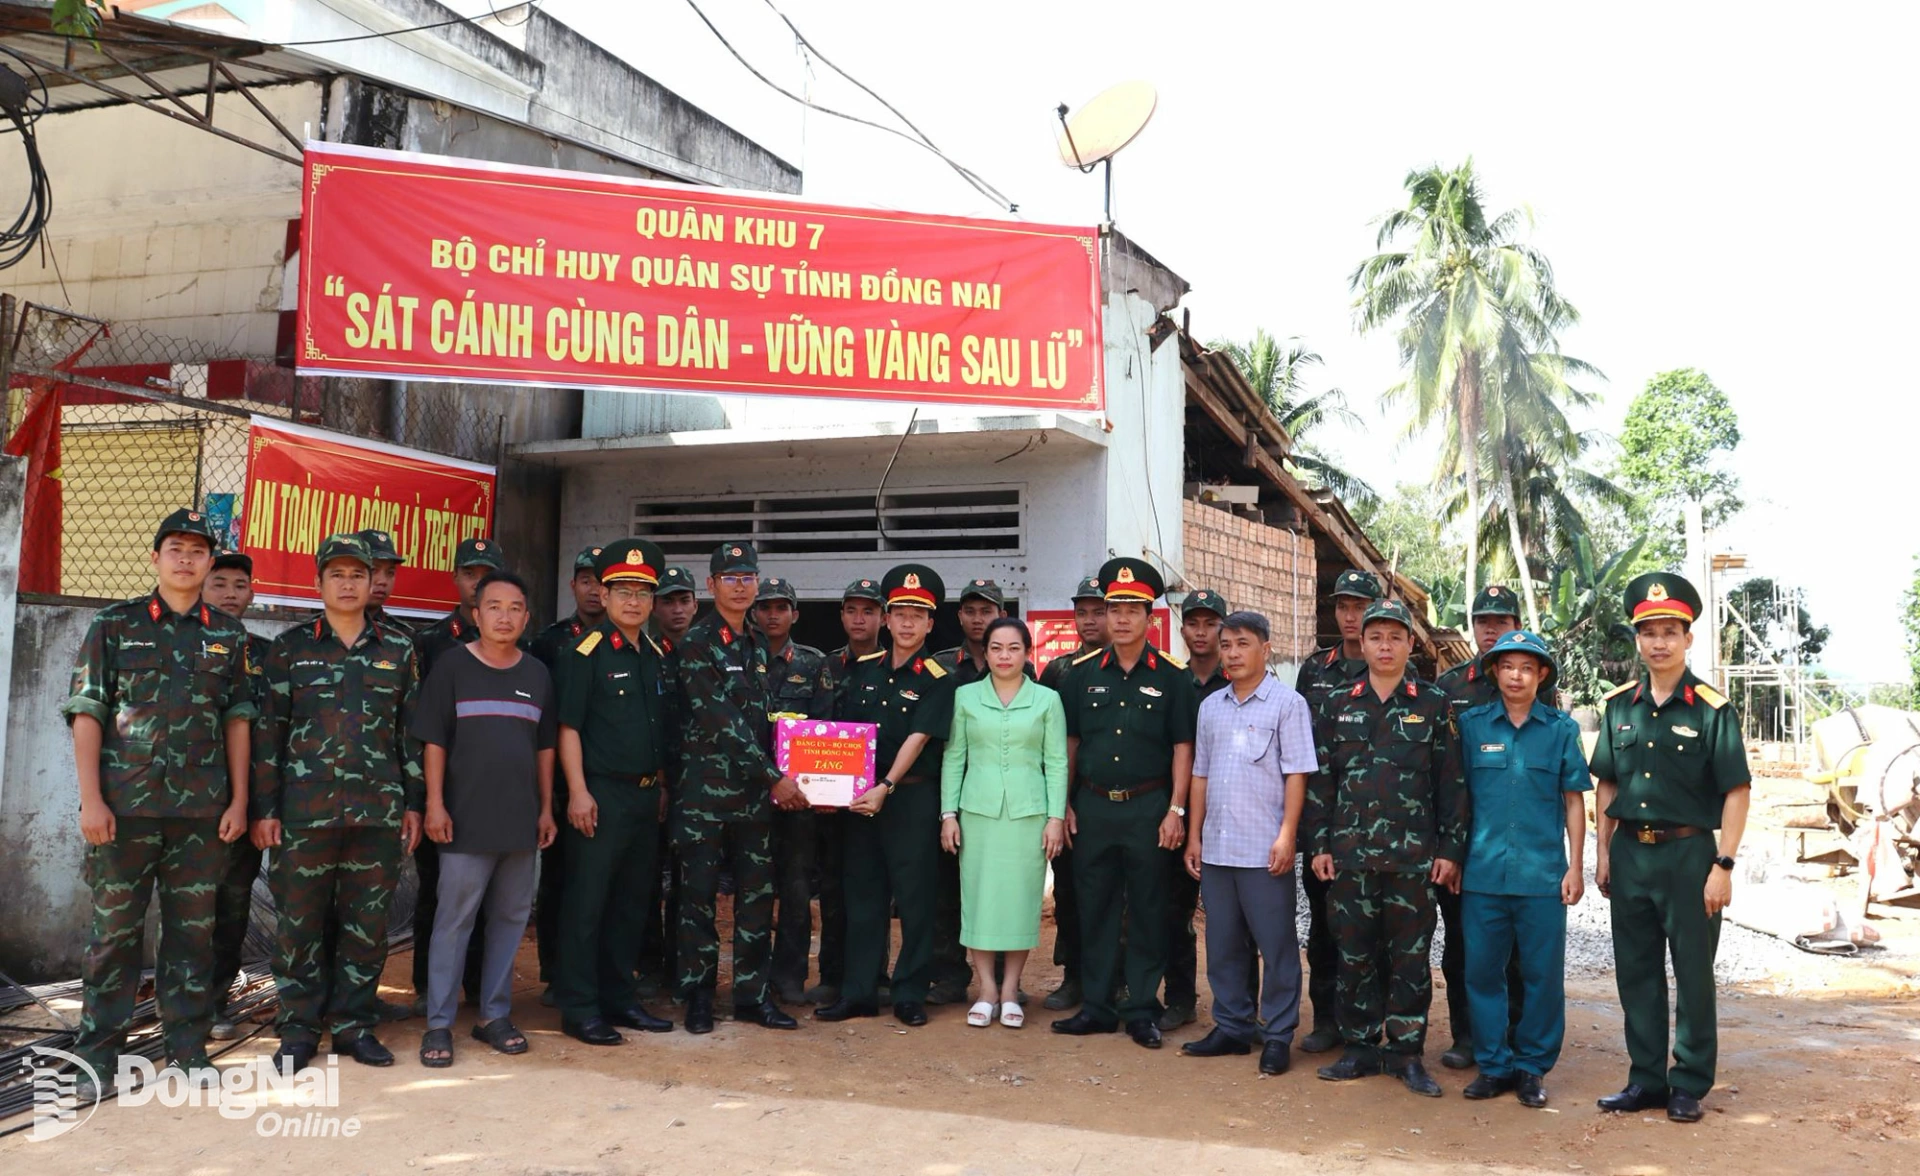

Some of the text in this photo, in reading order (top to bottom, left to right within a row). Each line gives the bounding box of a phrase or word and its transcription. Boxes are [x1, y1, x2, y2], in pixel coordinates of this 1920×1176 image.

[636, 206, 825, 251] QUÂN KHU 7
[431, 235, 1002, 311] BỘ CHỈ HUY QUÂN SỰ TỈNH ĐỒNG NAI
[430, 289, 533, 359] CÁNH
[545, 297, 645, 366] CÙNG
[657, 305, 729, 370] DÂN
[741, 344, 754, 355] -
[764, 313, 855, 378] VỮNG
[865, 319, 951, 383] VÀNG
[960, 334, 1020, 387] SAU
[246, 478, 277, 550] AN
[278, 472, 325, 555] TOÀN
[401, 492, 420, 568] LÀ
[422, 498, 460, 573] TRÊN
